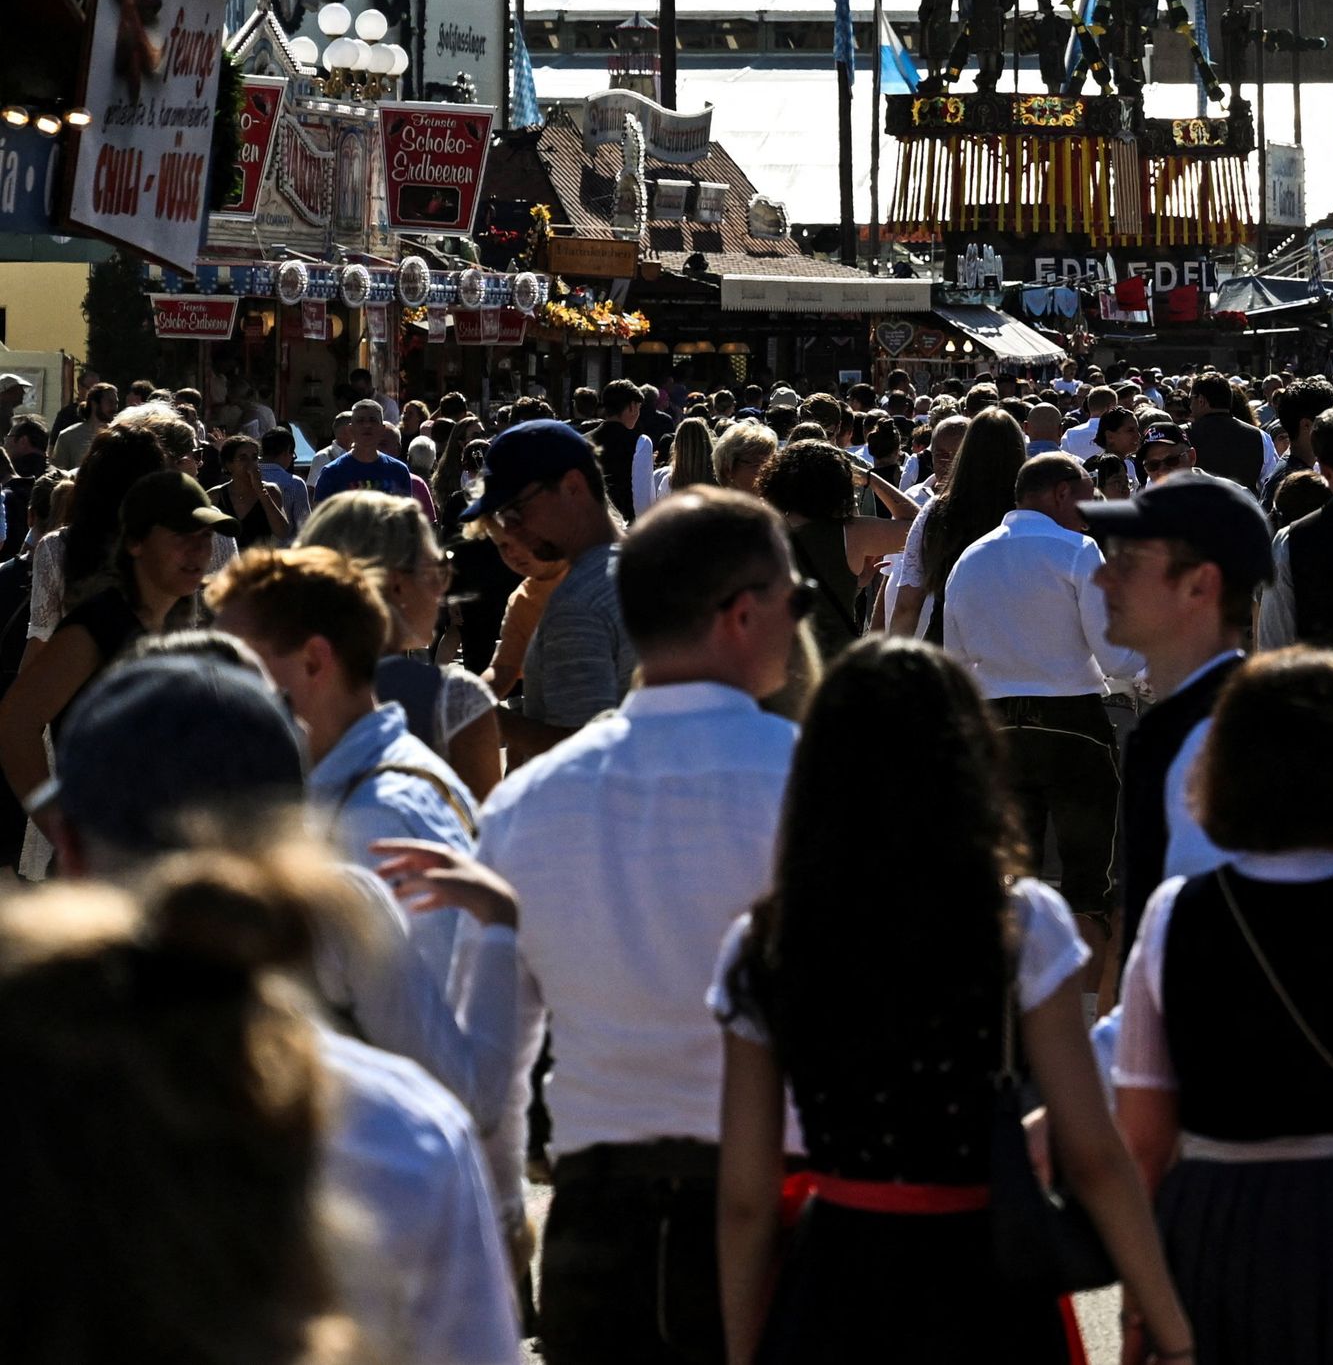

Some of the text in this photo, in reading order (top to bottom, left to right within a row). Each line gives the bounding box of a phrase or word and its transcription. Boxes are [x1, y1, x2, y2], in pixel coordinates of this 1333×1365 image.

[411, 113, 457, 129] Feinste
[400, 125, 473, 154] Schoko-
[392, 151, 473, 184] Erdbeeren
